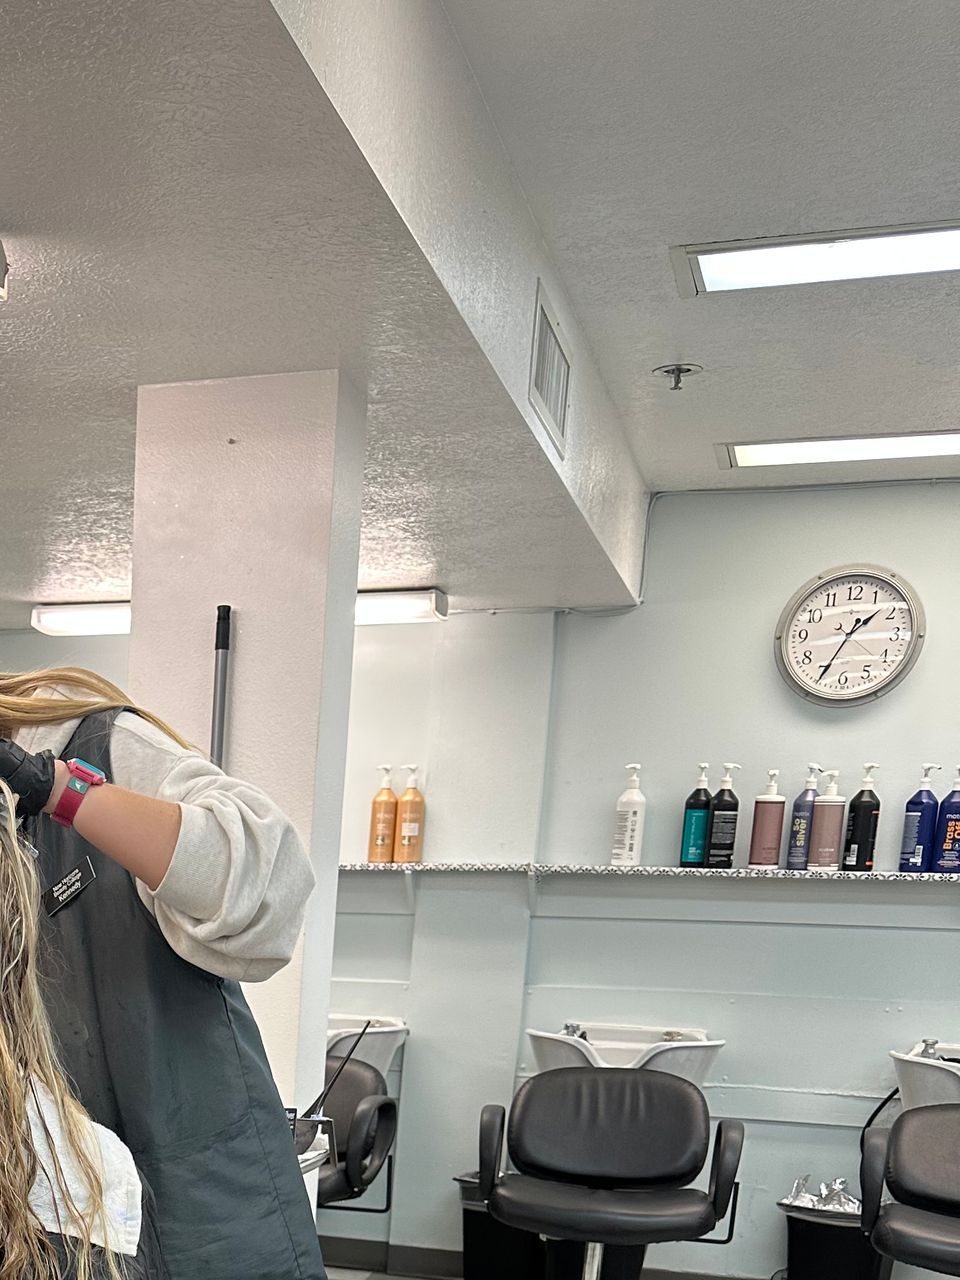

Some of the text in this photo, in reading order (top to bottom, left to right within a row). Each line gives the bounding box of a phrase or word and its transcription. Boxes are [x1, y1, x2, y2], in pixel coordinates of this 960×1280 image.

[824, 592, 837, 607] 11
[846, 585, 863, 601] 12
[872, 590, 879, 605] 1
[807, 608, 823, 624] 10
[885, 606, 896, 620] 2
[798, 629, 808, 644] 9
[889, 626, 900, 641] 3
[801, 650, 813, 665] 8
[879, 648, 889, 663] 4
[837, 670, 848, 685] 6
[860, 664, 872, 680] 5
[793, 818, 801, 831] So
[943, 821, 956, 850] Brass
[58, 880, 81, 902] Kennedy
